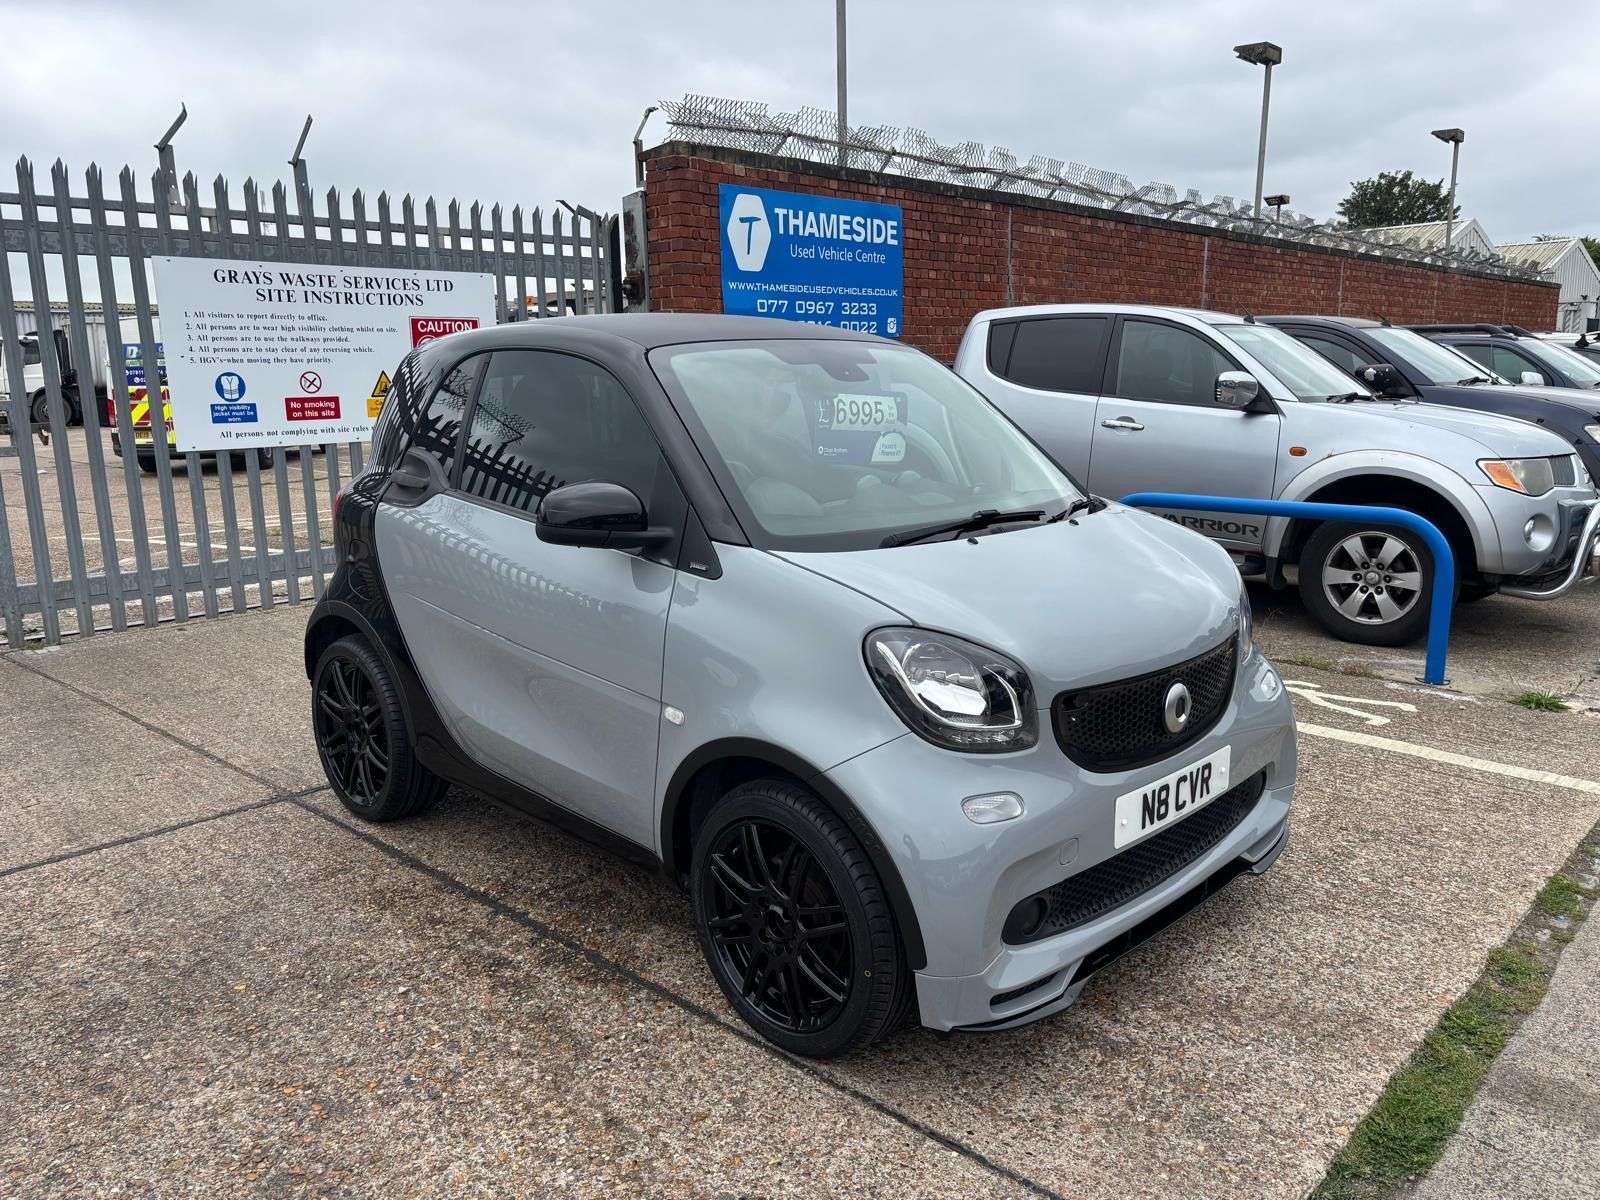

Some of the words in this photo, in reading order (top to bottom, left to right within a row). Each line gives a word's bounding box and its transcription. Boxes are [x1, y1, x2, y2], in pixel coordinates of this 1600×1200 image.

[774, 207, 899, 246] THAMESIDE
[790, 243, 815, 259] Used
[818, 245, 853, 262] Vehicle
[855, 248, 886, 264] Centre
[213, 268, 273, 286] GRAYS
[279, 272, 337, 288] WASTE
[343, 275, 421, 292] SERVICES
[426, 279, 454, 293] LTD
[255, 287, 297, 303] SITE
[303, 290, 424, 306] INSTRUCTIONS
[728, 281, 898, 297] WWW.THAMESIDEUSEDVEHICLES.CO.UK
[757, 299, 788, 313] 077
[795, 301, 834, 315] 0967
[841, 302, 877, 315] 3233
[184, 311, 191, 319] 1.
[193, 311, 205, 319] All
[207, 312, 235, 320] visitors
[236, 312, 244, 320] to
[246, 313, 268, 322] report
[270, 312, 296, 322] directly
[307, 313, 328, 321] office.
[186, 323, 193, 331] 2.
[195, 323, 207, 331] All
[210, 324, 237, 333] persons
[253, 324, 260, 332] to
[281, 324, 296, 333] high
[298, 324, 327, 333] visibility
[328, 326, 354, 334] clothing
[356, 325, 374, 334] whilst
[385, 326, 398, 334] site.
[417, 320, 473, 333] CAUTION
[211, 335, 238, 344] persons
[277, 335, 288, 343] the
[290, 335, 321, 344] walkways
[213, 346, 240, 355] persons
[265, 346, 278, 354] stay
[300, 345, 307, 353] of
[323, 346, 351, 355] reversing
[246, 357, 271, 365] moving
[273, 357, 287, 365] they
[290, 401, 302, 409] No
[304, 400, 336, 410] smoking
[836, 398, 885, 426] 6995
[220, 430, 232, 439] All
[235, 430, 264, 439] persons
[281, 428, 318, 437] complying
[320, 426, 336, 434] with
[1163, 513, 1259, 538] ARRIOR
[1141, 783, 1170, 830] N8
[1174, 762, 1212, 812] CVR
